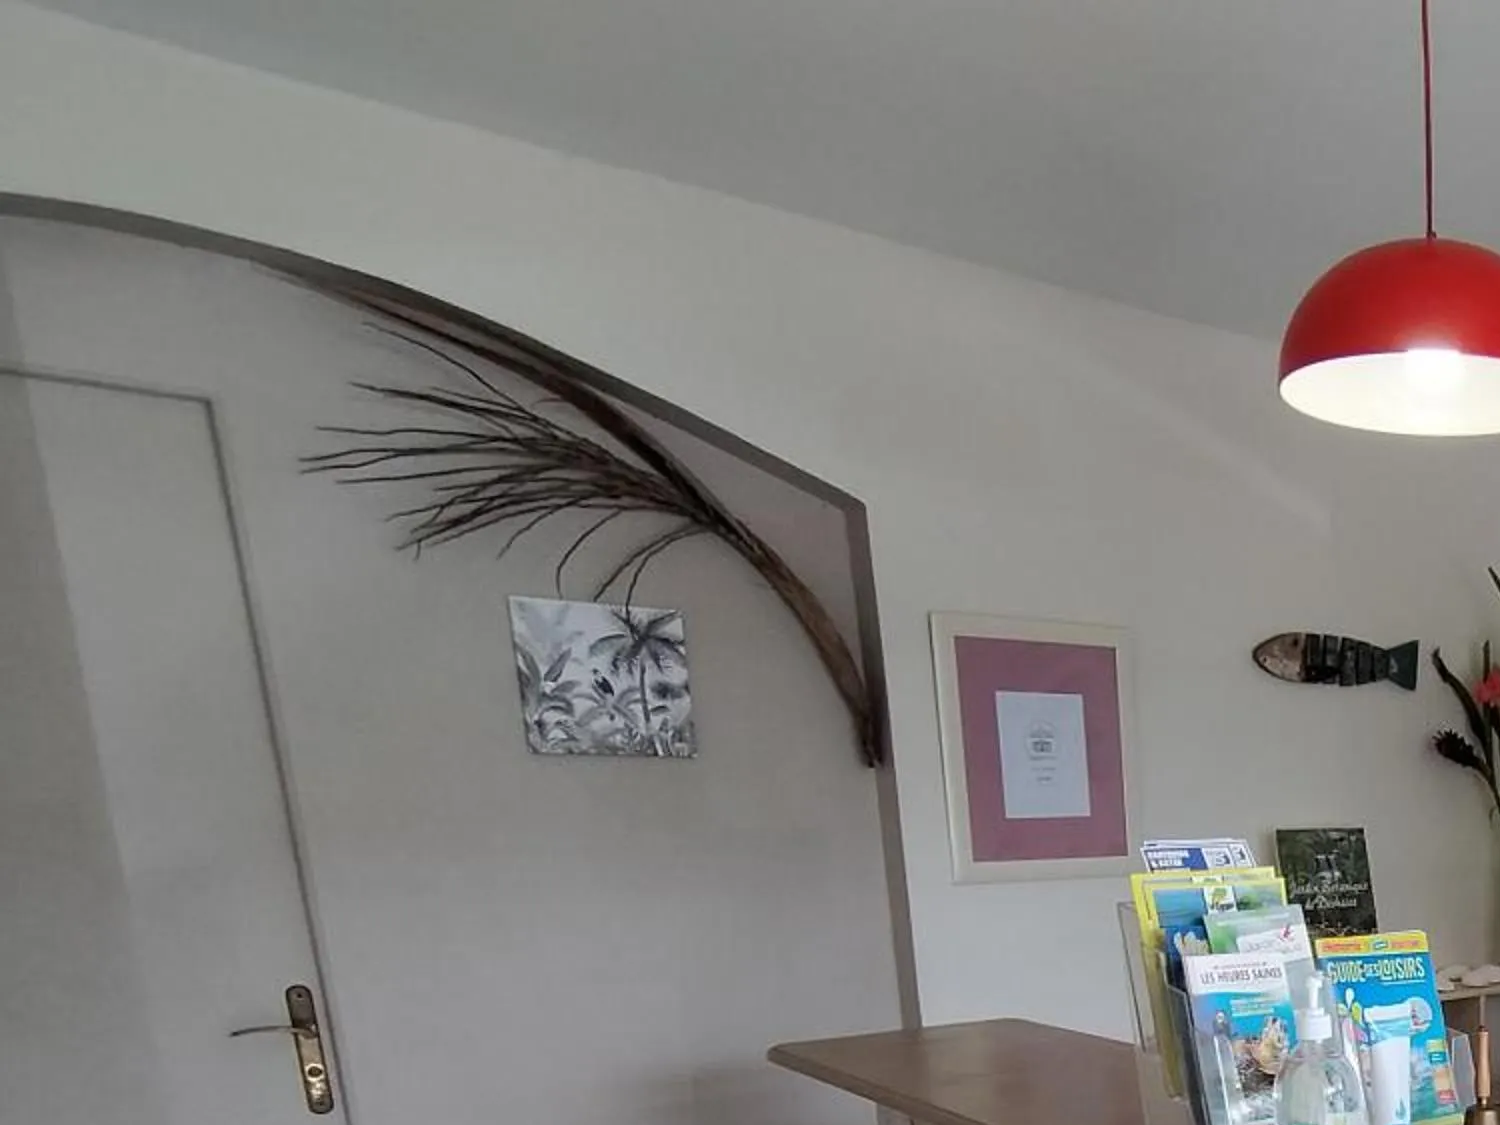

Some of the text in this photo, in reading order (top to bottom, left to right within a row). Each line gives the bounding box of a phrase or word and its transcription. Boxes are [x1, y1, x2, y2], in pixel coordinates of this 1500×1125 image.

[1217, 969, 1251, 983] HEURES
[1251, 967, 1283, 980] SAINES
[1327, 960, 1366, 983] GUIDE
[1380, 957, 1426, 980] LOISIRS
